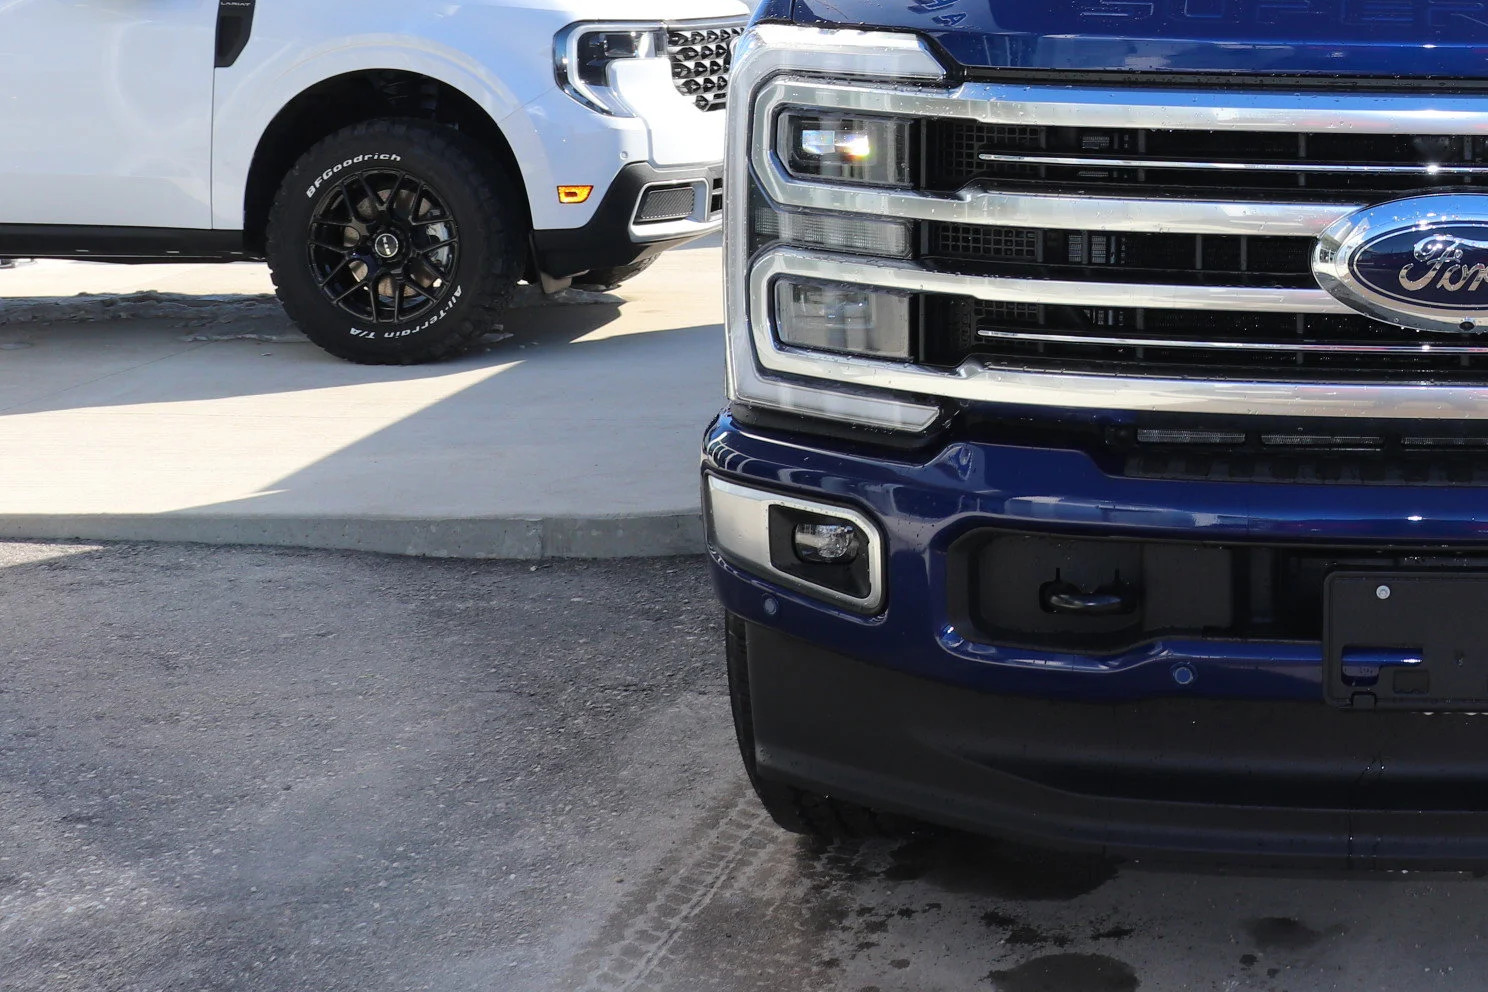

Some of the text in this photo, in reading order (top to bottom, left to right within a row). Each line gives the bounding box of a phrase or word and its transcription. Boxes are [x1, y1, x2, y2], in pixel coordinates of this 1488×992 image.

[306, 153, 401, 198] BFGoodrich
[349, 285, 462, 339] All-Terrain T/A
